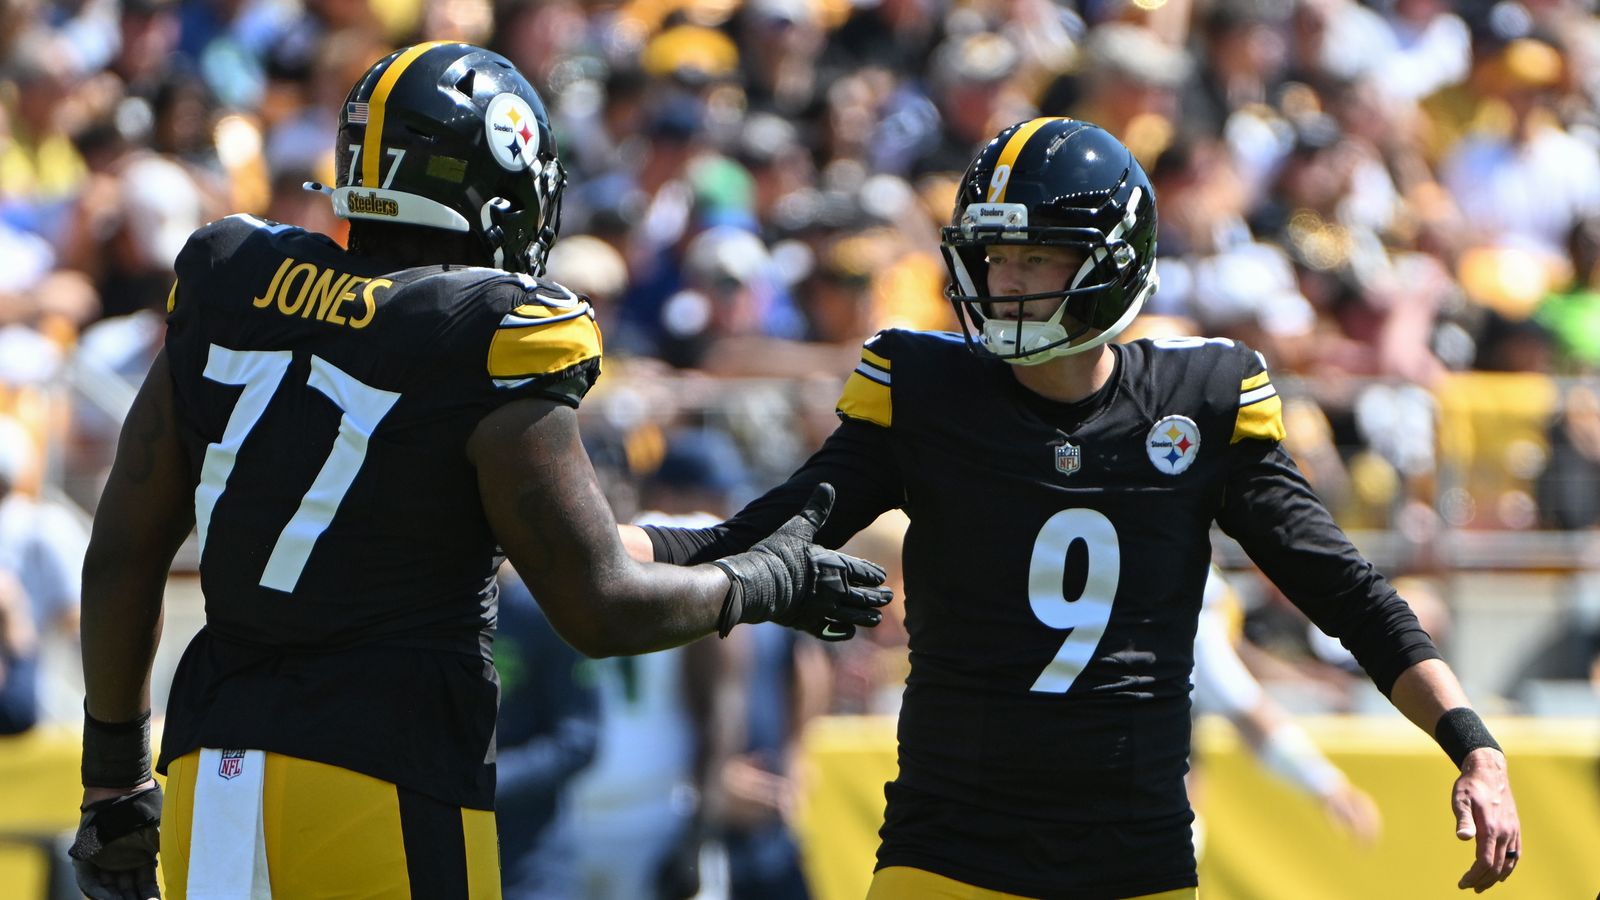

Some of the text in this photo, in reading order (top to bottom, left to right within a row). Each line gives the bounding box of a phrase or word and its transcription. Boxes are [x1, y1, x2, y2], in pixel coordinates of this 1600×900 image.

[494, 123, 513, 133] Steelers
[347, 144, 407, 189] 77
[989, 164, 1011, 203] 9
[348, 190, 399, 216] Steelers
[980, 208, 1004, 217] Steelers
[252, 257, 393, 329] JONES
[1151, 440, 1173, 448] Steelers
[195, 343, 402, 593] 77
[1059, 457, 1077, 470] NFL
[1028, 507, 1121, 693] 9
[220, 759, 241, 776] NFL
